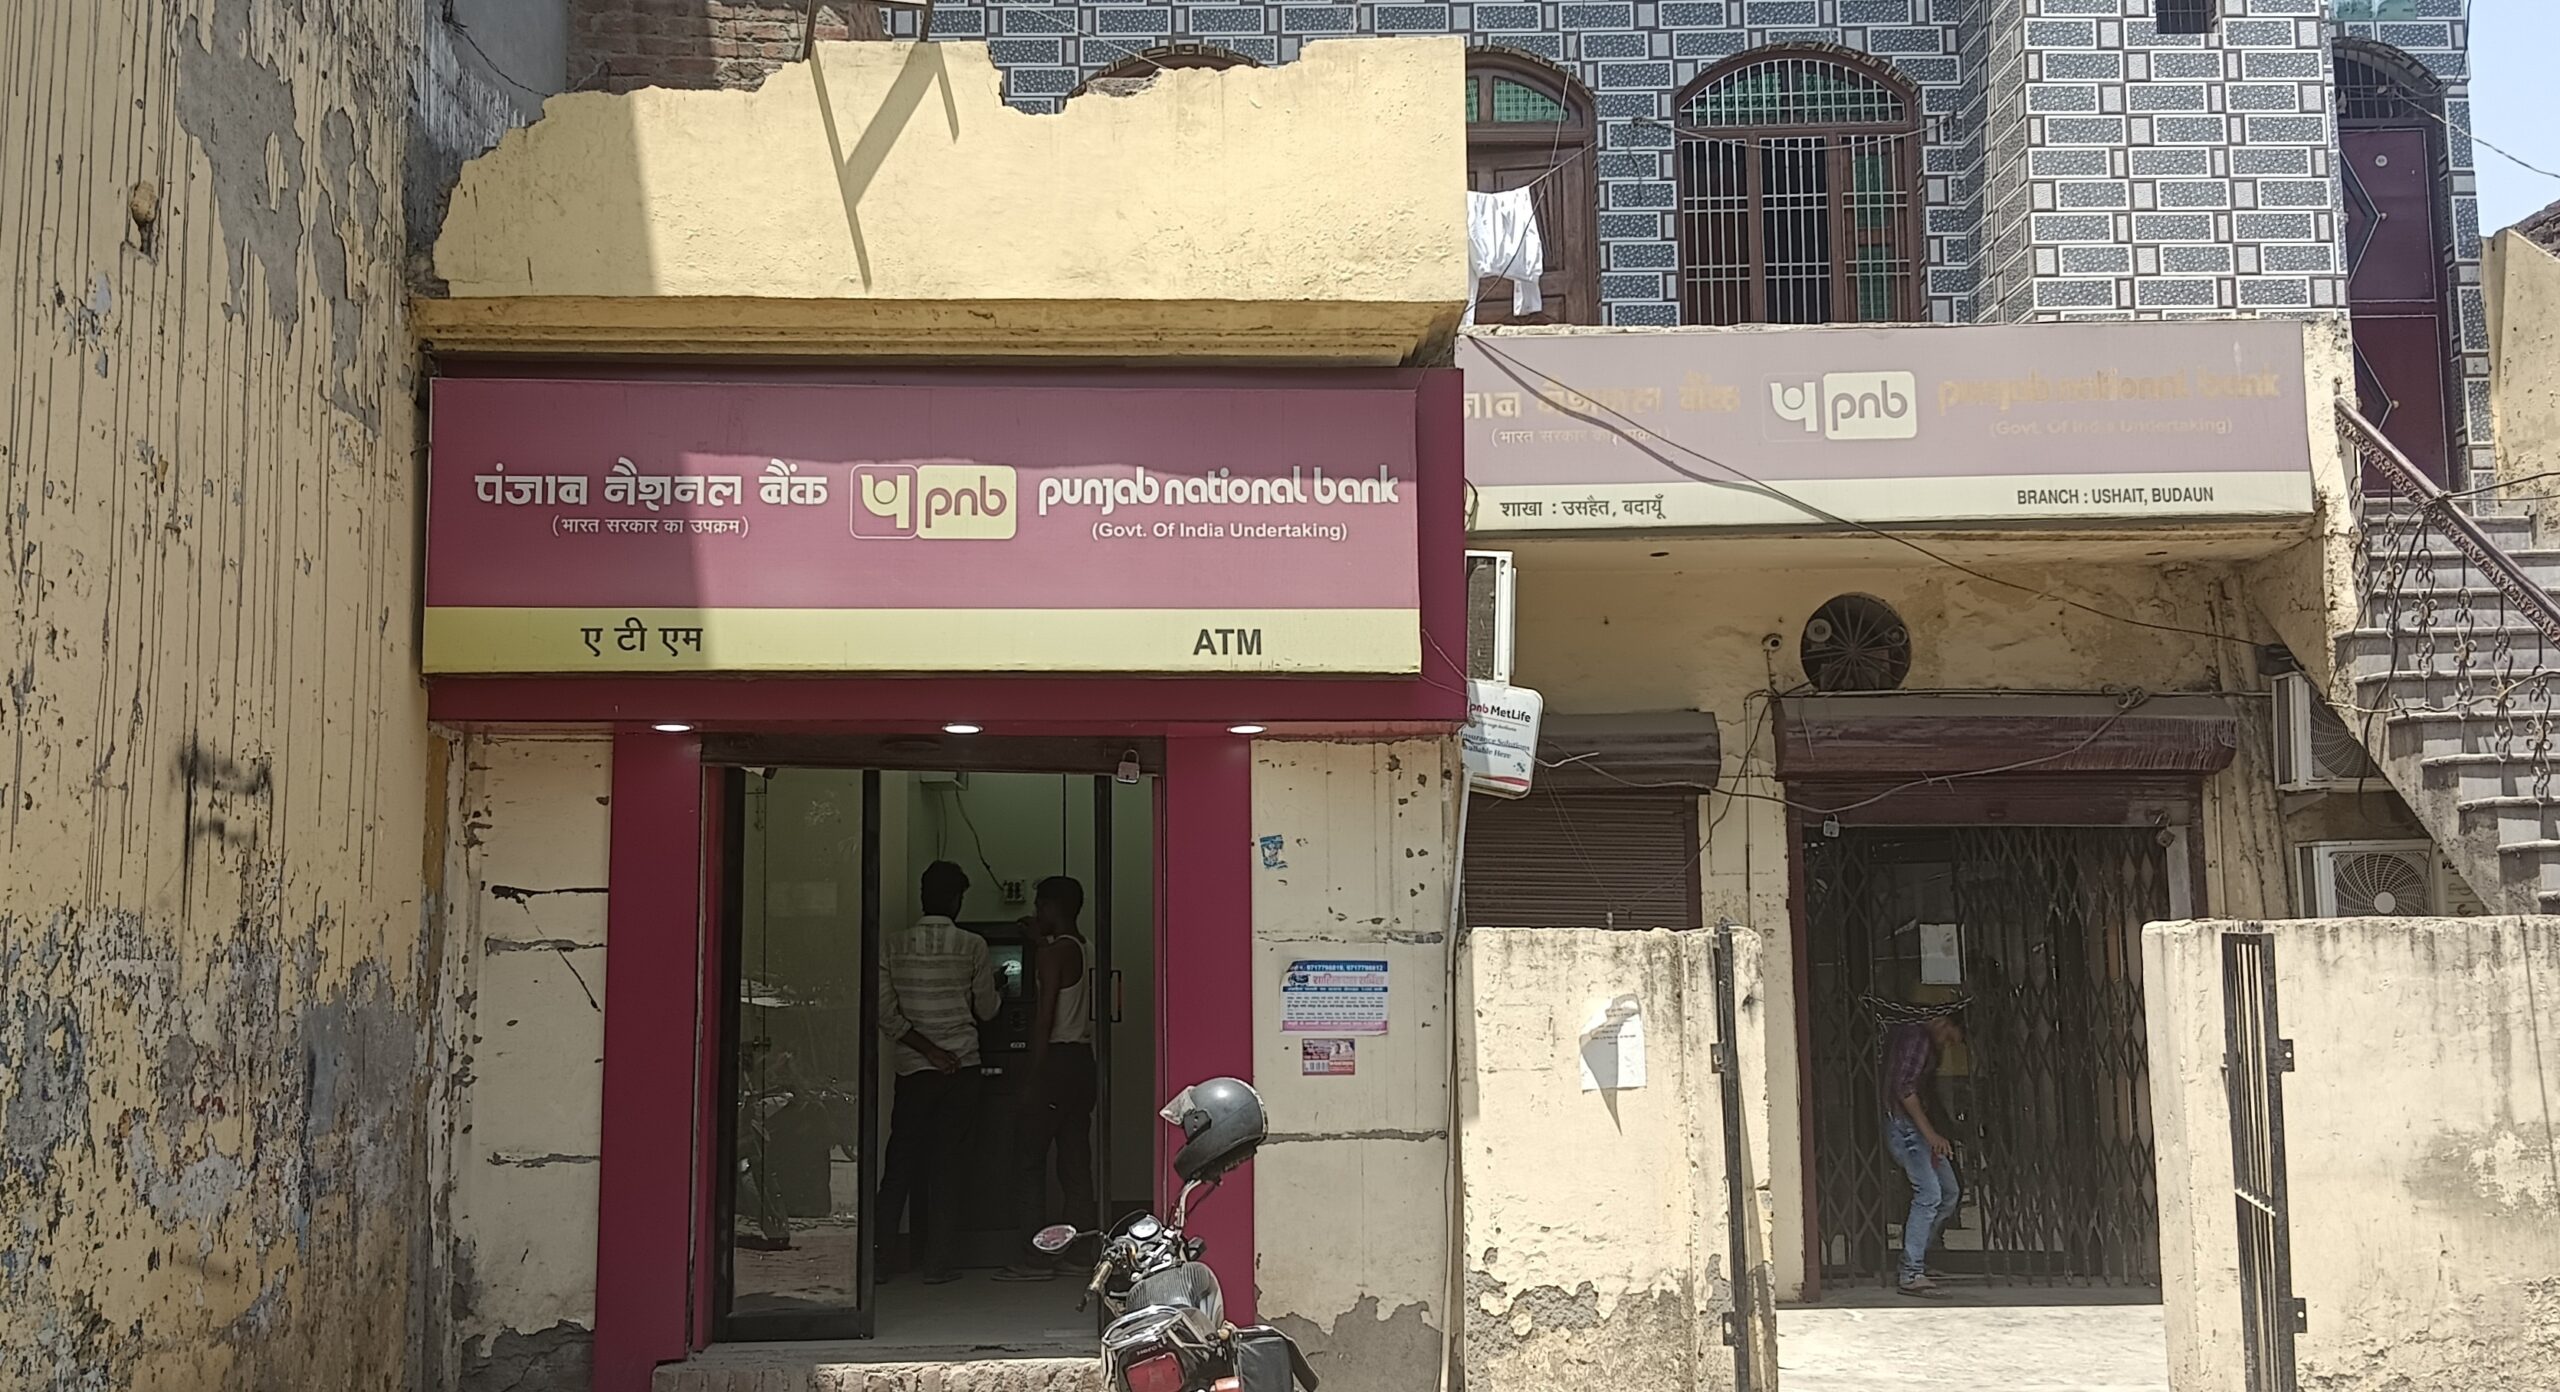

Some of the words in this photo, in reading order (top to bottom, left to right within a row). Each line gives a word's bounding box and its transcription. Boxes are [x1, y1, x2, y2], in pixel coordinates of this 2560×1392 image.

[1832, 380, 1908, 431] pnb
[475, 463, 588, 505] पंजाब
[605, 456, 742, 511] नैशनल
[758, 457, 828, 505] बैंक
[1038, 467, 1159, 517] punjab
[1164, 465, 1307, 505] national
[1313, 464, 1399, 504] bank
[2017, 489, 2079, 505] BRANCH
[2092, 488, 2148, 506] USHAIT,
[2152, 487, 2214, 503] BUDAUN
[925, 475, 1007, 528] pnb
[1500, 501, 1542, 517] शाखा
[552, 515, 599, 538] (भारत
[606, 519, 658, 534] सरकार
[665, 519, 683, 534] का
[690, 515, 750, 538] उपक्रम)
[1092, 522, 1148, 541] (Govt.
[1153, 522, 1176, 538] Of
[1180, 522, 1224, 538] India
[1230, 521, 1348, 541] Undertaking)
[581, 628, 603, 657] ए
[614, 616, 647, 652] टी
[659, 628, 703, 657] एम
[1192, 629, 1262, 655] ATM
[1469, 703, 1489, 714] pnb
[1490, 705, 1531, 723] MetLife
